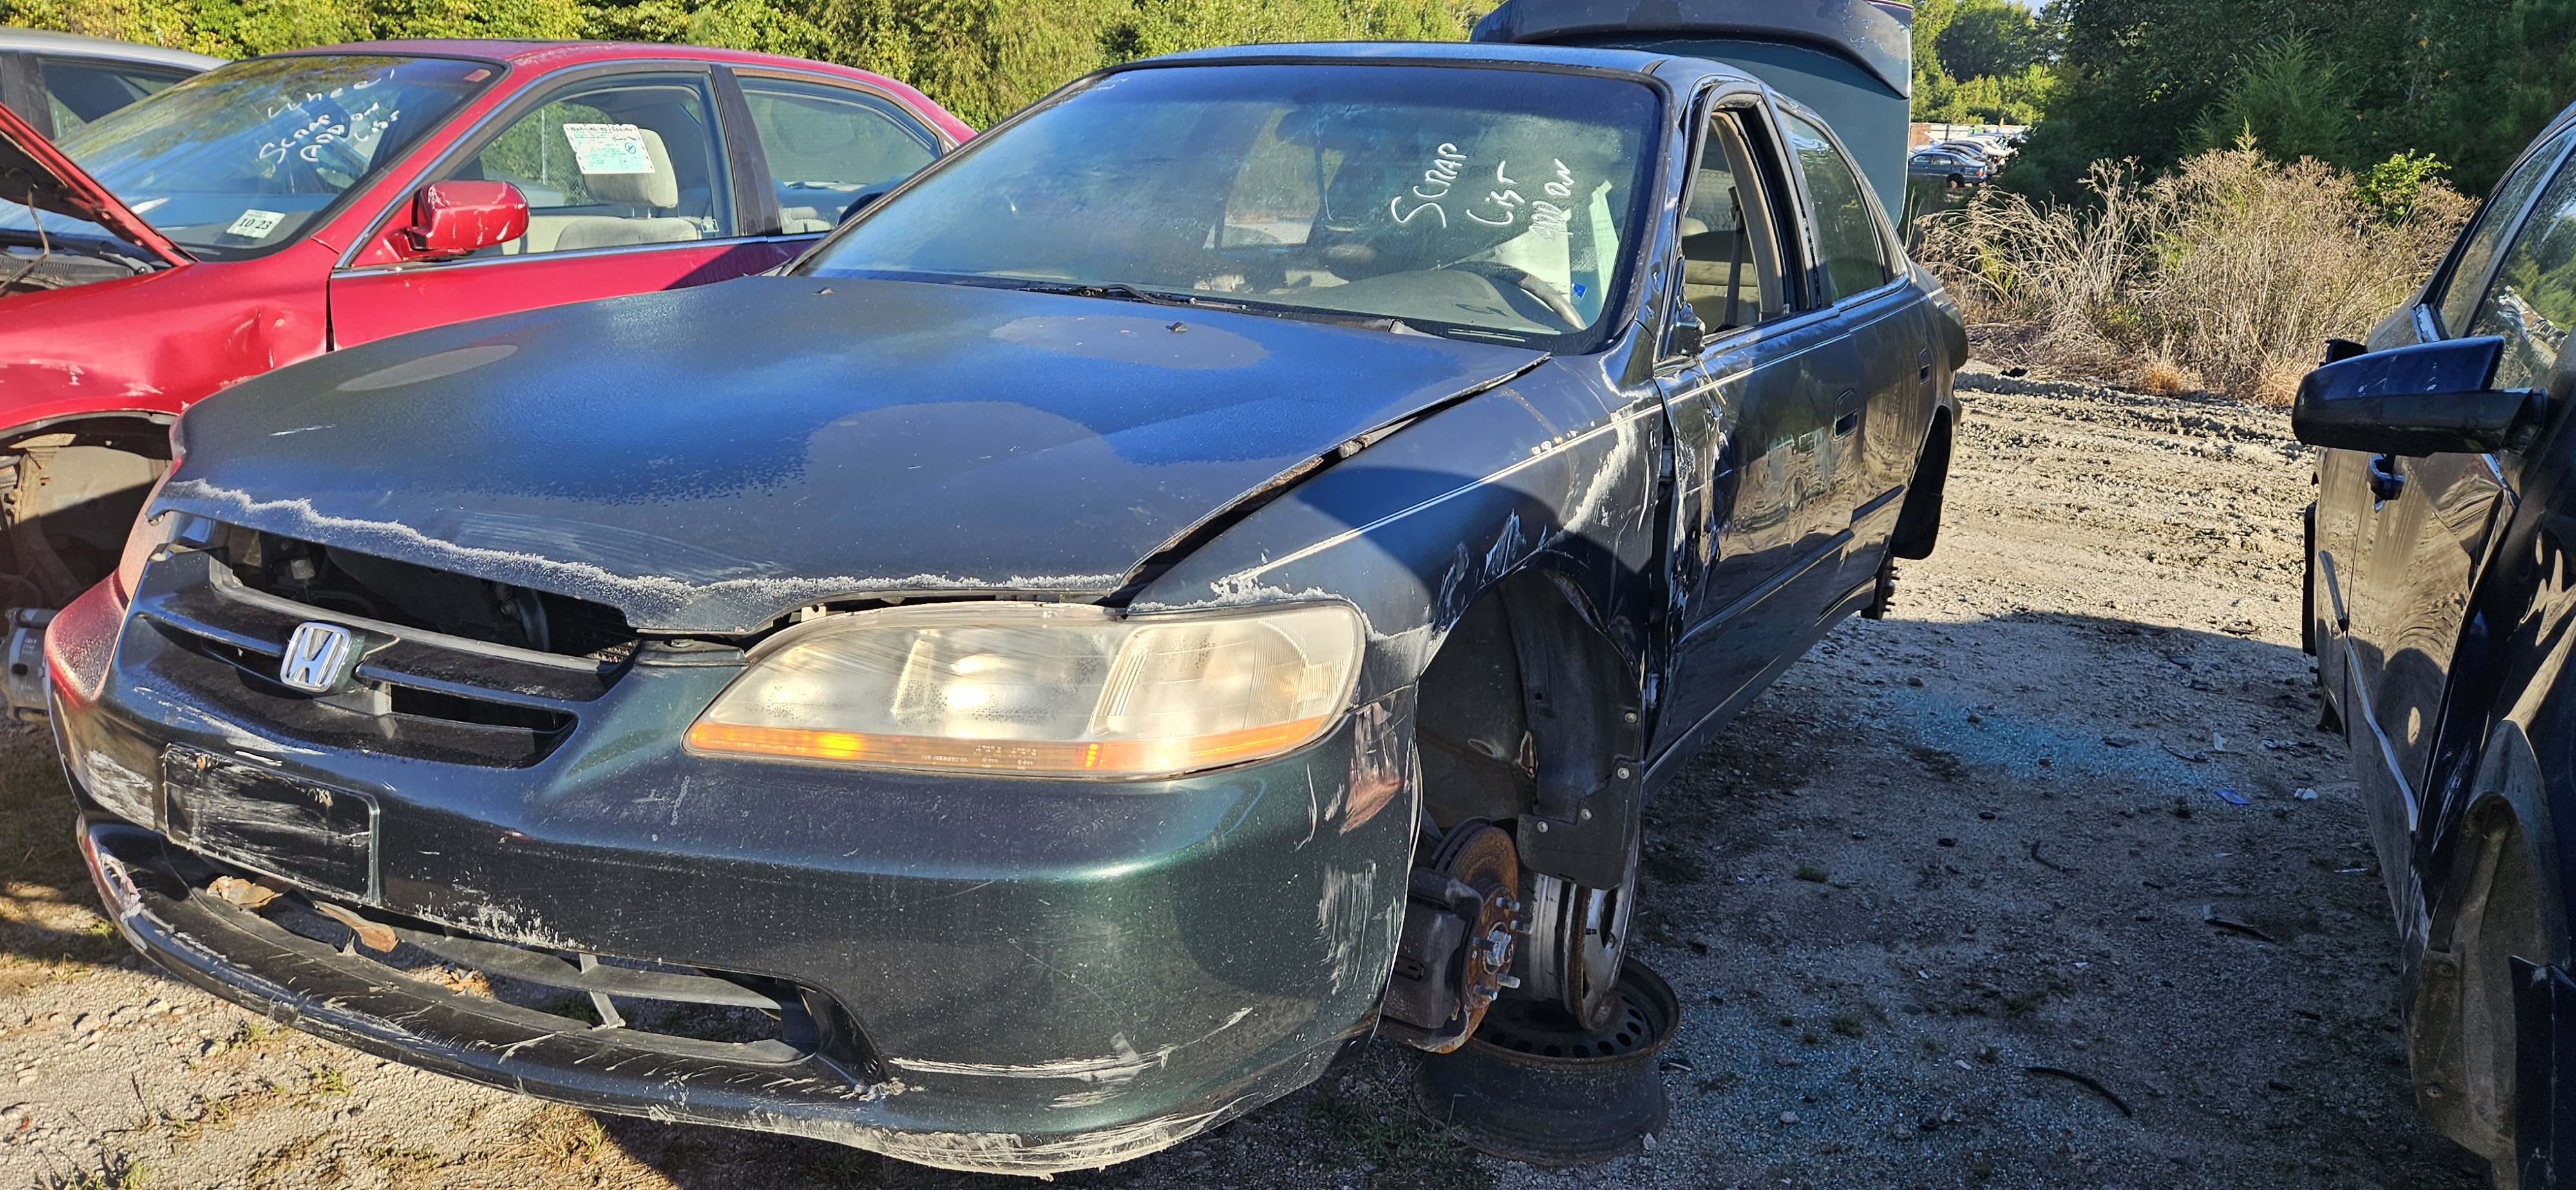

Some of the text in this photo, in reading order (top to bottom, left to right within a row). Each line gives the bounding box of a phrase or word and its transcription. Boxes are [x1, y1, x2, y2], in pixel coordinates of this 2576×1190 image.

[1390, 142, 1468, 229] SCRAP
[238, 218, 272, 230] 10 23
